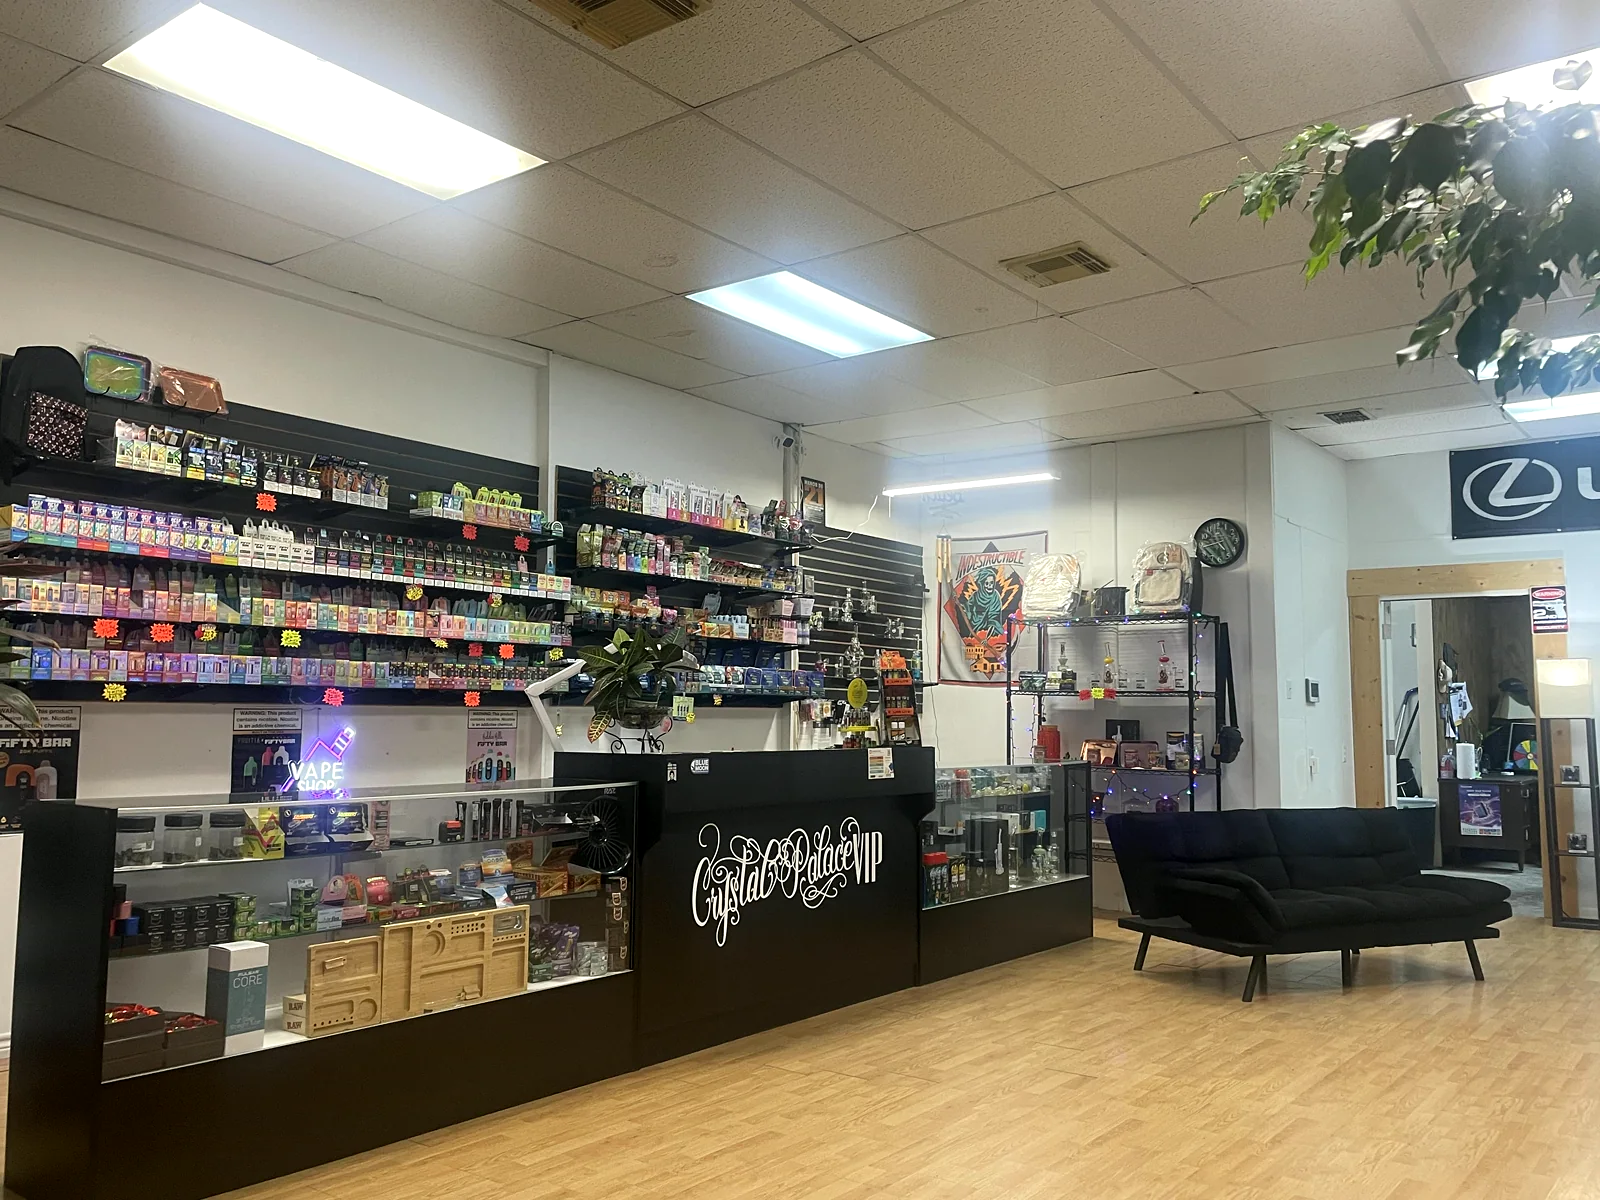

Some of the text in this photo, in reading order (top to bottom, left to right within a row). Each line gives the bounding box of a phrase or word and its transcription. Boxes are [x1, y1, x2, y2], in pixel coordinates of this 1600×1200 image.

[955, 549, 1026, 581] INDESTRUCTIBLE
[42, 738, 72, 747] BAR
[291, 762, 342, 780] VAPE
[298, 779, 335, 791] SHOP
[692, 817, 883, 947] Crystal Palace VIP
[233, 974, 263, 988] CORE
[289, 1002, 303, 1010] RAW
